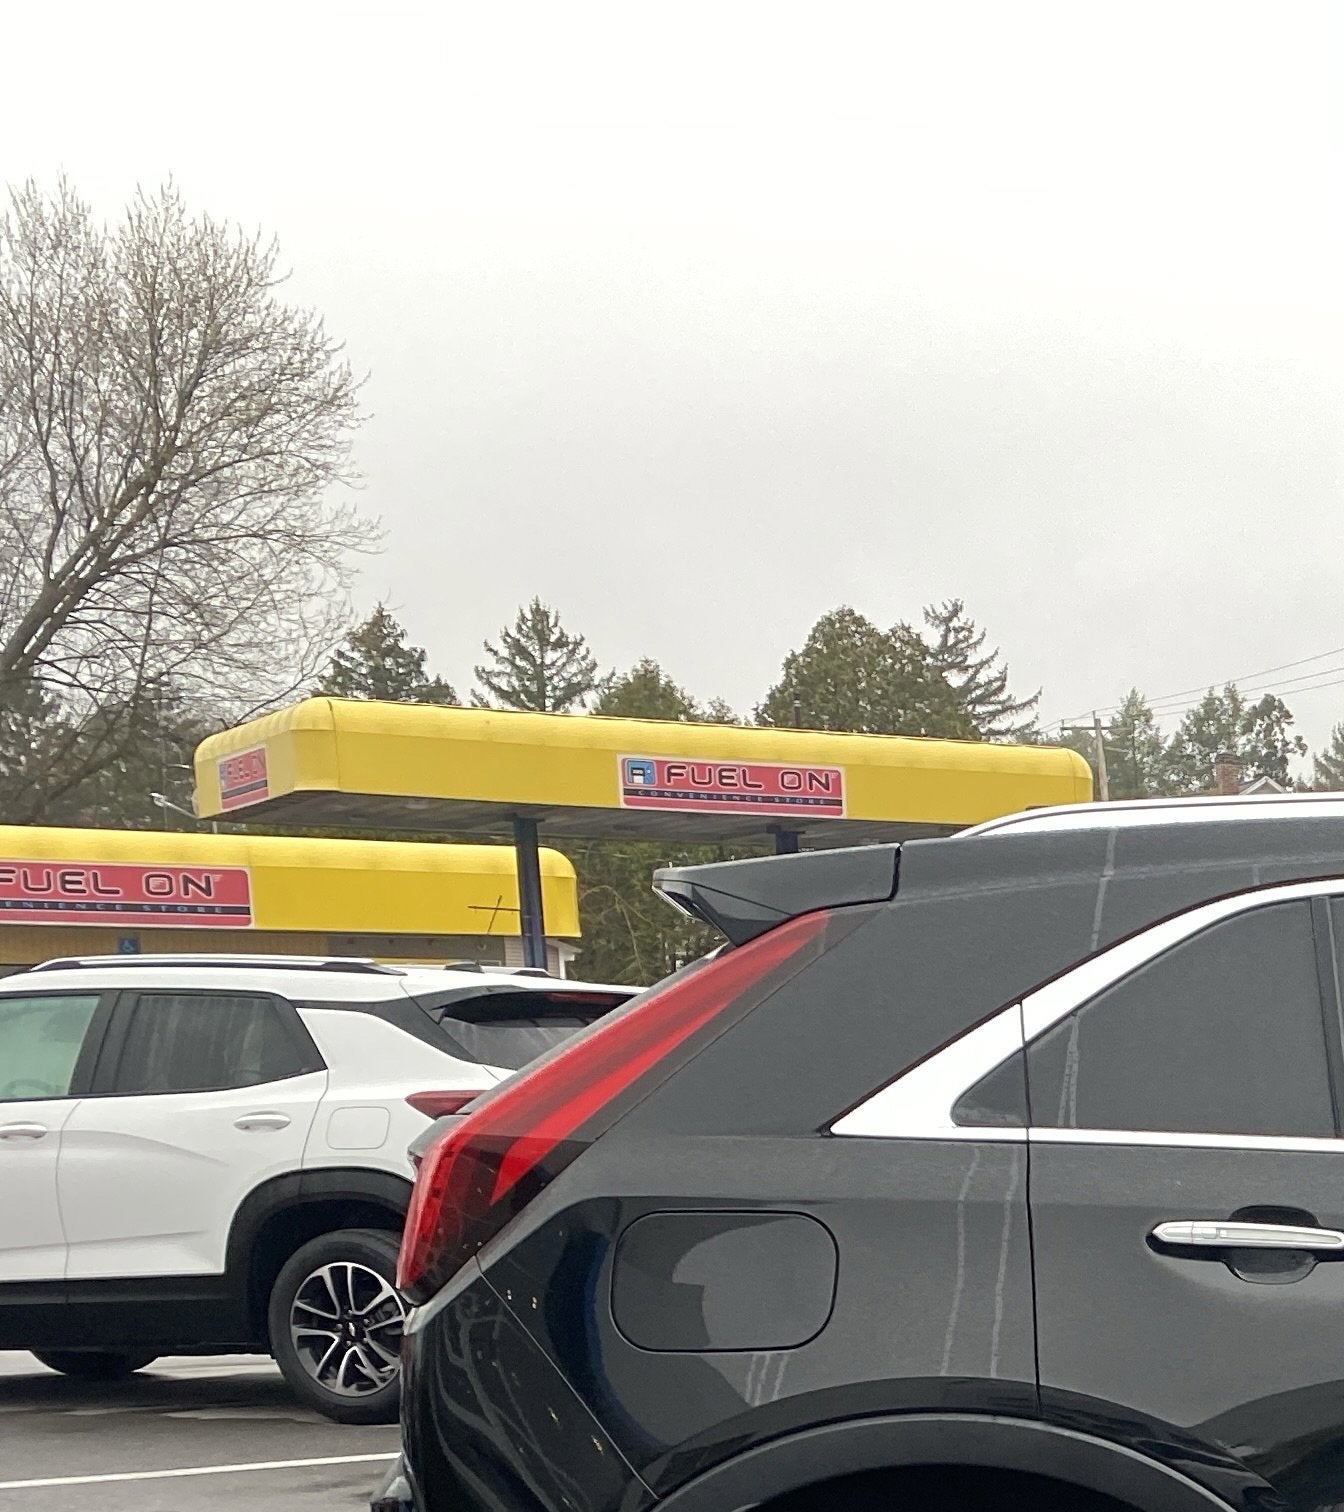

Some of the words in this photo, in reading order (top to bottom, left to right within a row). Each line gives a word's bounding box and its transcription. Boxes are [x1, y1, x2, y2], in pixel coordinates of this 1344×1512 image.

[665, 764, 763, 789] FUEL
[779, 770, 831, 792] ON
[638, 789, 763, 803] CONVENIENCE
[775, 797, 825, 805] STORE
[0, 868, 121, 896] FUEL
[144, 873, 213, 897] ON
[142, 904, 223, 914] STORE
